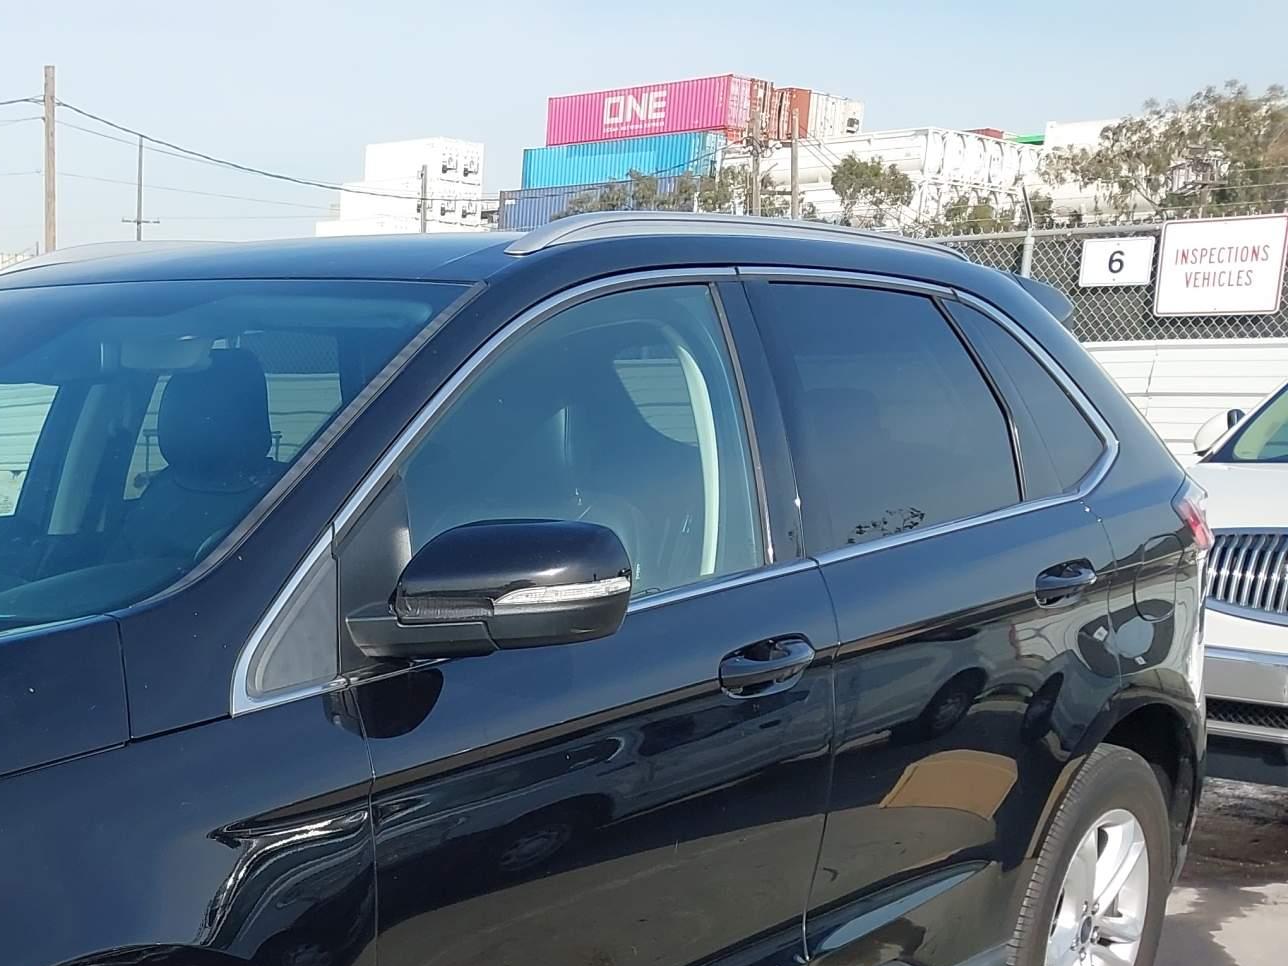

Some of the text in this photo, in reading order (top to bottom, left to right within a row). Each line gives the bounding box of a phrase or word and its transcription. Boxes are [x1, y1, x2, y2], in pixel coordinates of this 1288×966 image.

[603, 90, 667, 124] ONE
[1108, 250, 1125, 274] 6
[1174, 244, 1271, 266] INSPECTIONS
[1184, 269, 1254, 289] VEHICLES
